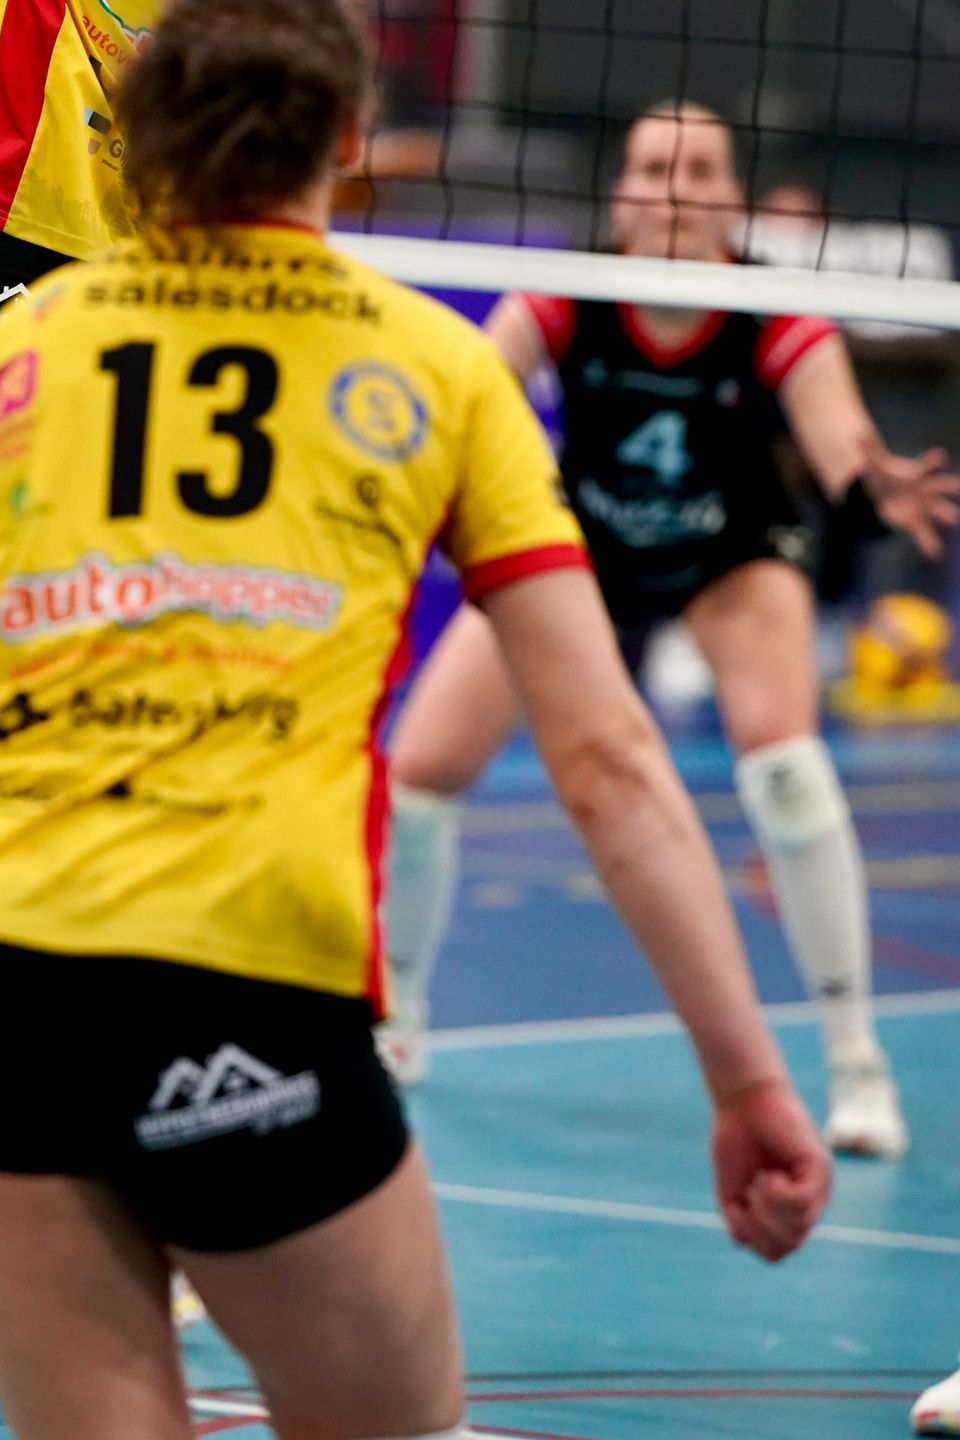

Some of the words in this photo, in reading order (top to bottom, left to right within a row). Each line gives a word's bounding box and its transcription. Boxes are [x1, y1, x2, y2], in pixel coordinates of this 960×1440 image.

[84, 277, 384, 326] salesdock
[98, 338, 280, 520] 13
[615, 408, 693, 487] 4
